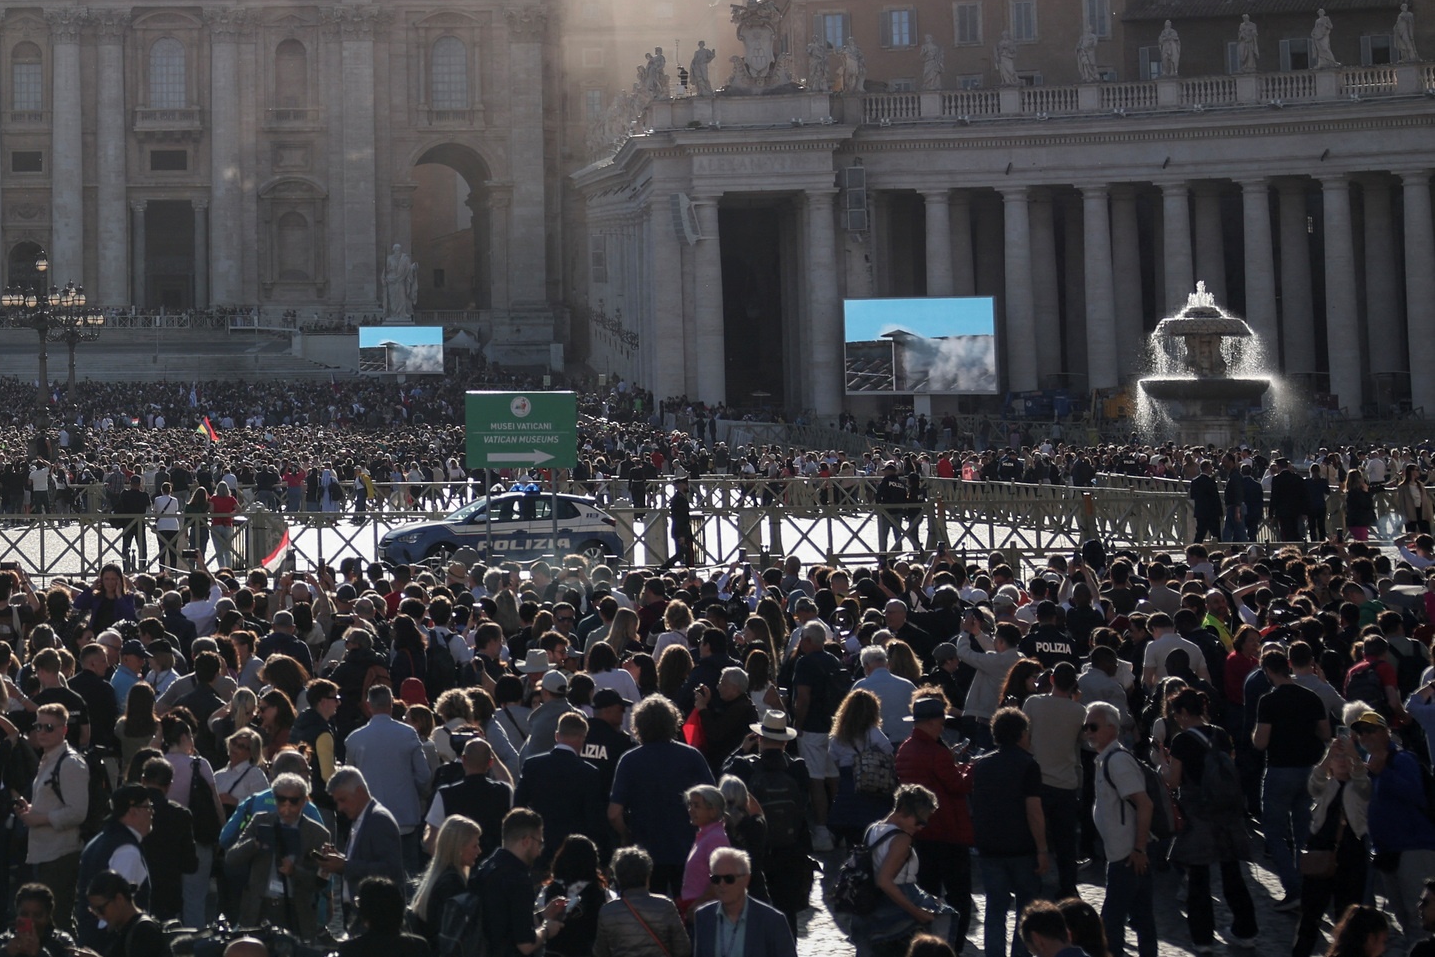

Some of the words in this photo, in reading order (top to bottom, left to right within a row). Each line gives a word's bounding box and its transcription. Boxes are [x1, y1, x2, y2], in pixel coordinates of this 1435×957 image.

[490, 422, 515, 431] MUSEI
[516, 422, 553, 431] VATICANI
[483, 435, 518, 444] VATICAN
[518, 435, 559, 444] MUSEUMS
[477, 538, 571, 552] POLIZIA
[1035, 641, 1072, 655] POLIZIA
